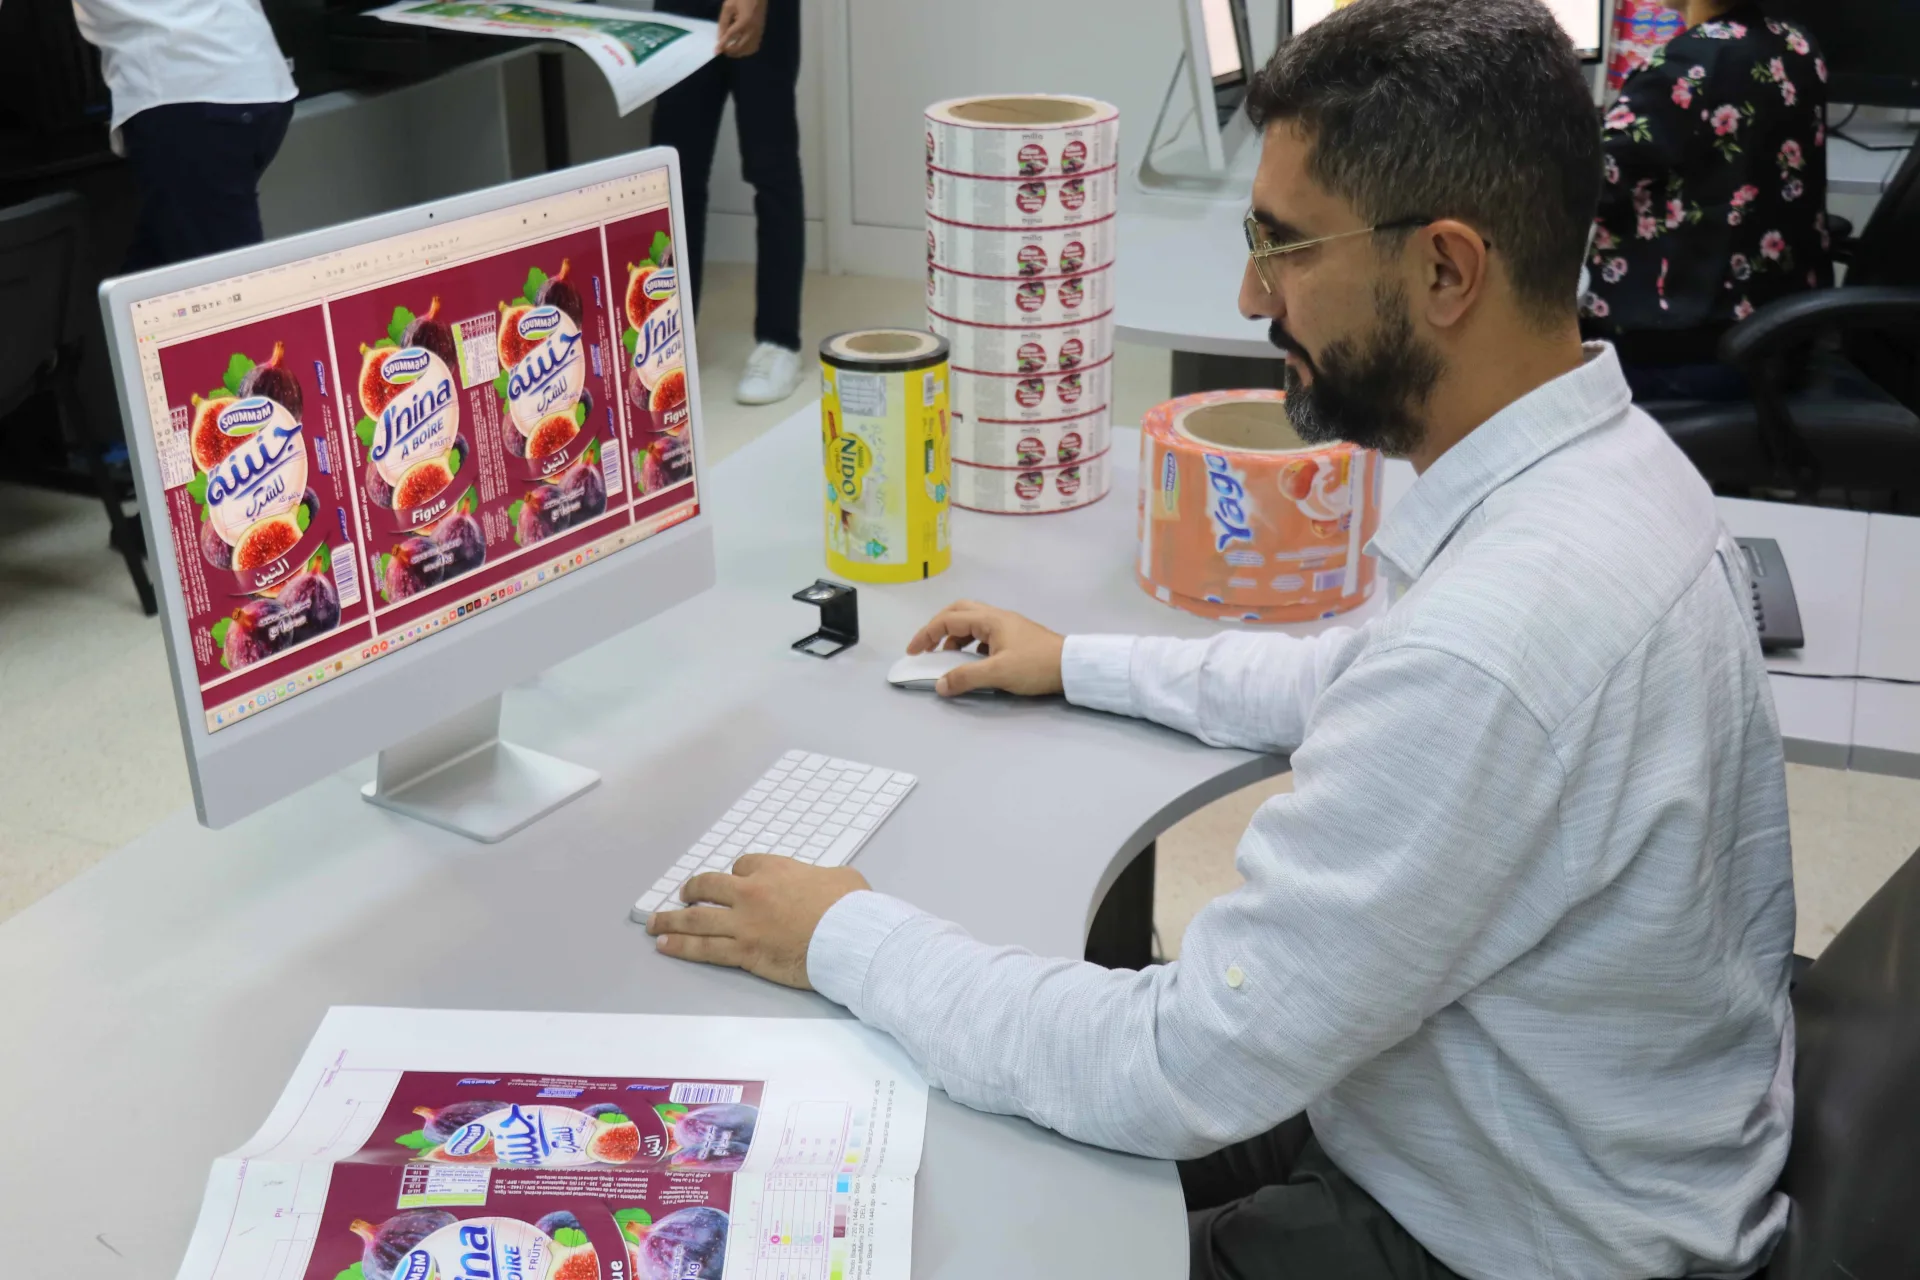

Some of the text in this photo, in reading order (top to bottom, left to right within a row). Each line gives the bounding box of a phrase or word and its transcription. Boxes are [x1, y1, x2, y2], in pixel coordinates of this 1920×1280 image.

[521, 311, 560, 333] SOUMMaM
[384, 353, 429, 376] SOUMMaM
[220, 401, 272, 430] SOUMMaM
[372, 379, 452, 461] J'nina
[542, 450, 569, 474] التين
[840, 438, 857, 496] NIDO
[412, 499, 447, 524] Figue
[254, 558, 290, 587] التين
[529, 1236, 543, 1270] FRUITS
